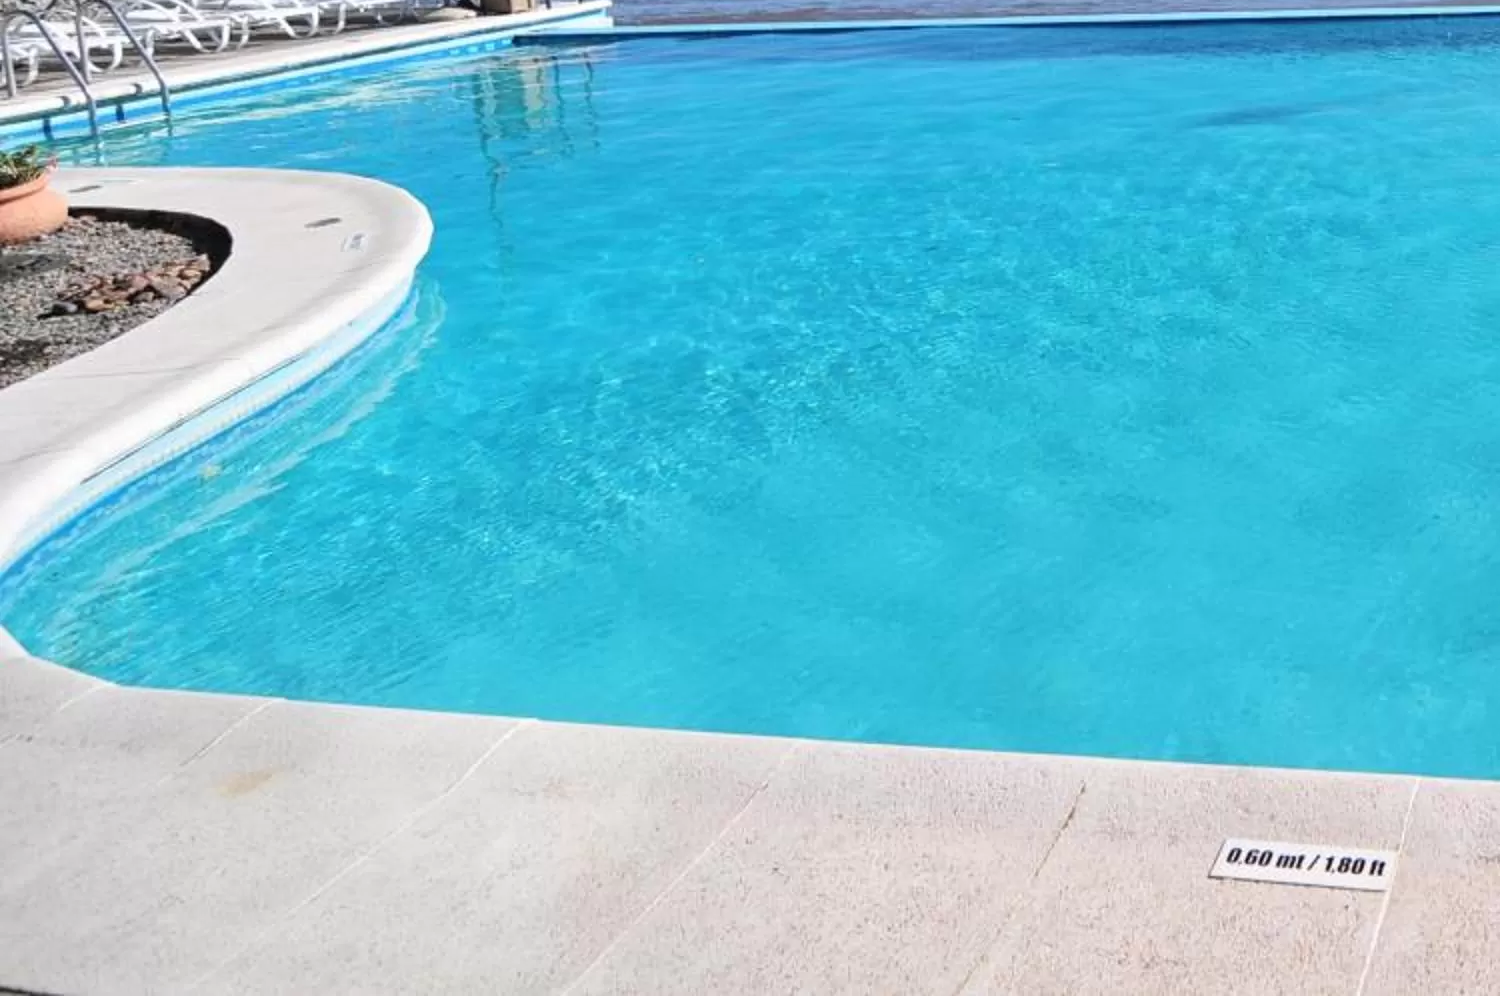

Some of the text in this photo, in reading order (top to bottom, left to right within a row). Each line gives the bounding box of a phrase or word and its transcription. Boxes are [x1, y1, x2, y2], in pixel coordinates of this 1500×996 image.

[1275, 853, 1305, 870] mt
[1307, 854, 1321, 871] /
[1369, 859, 1386, 877] ft
